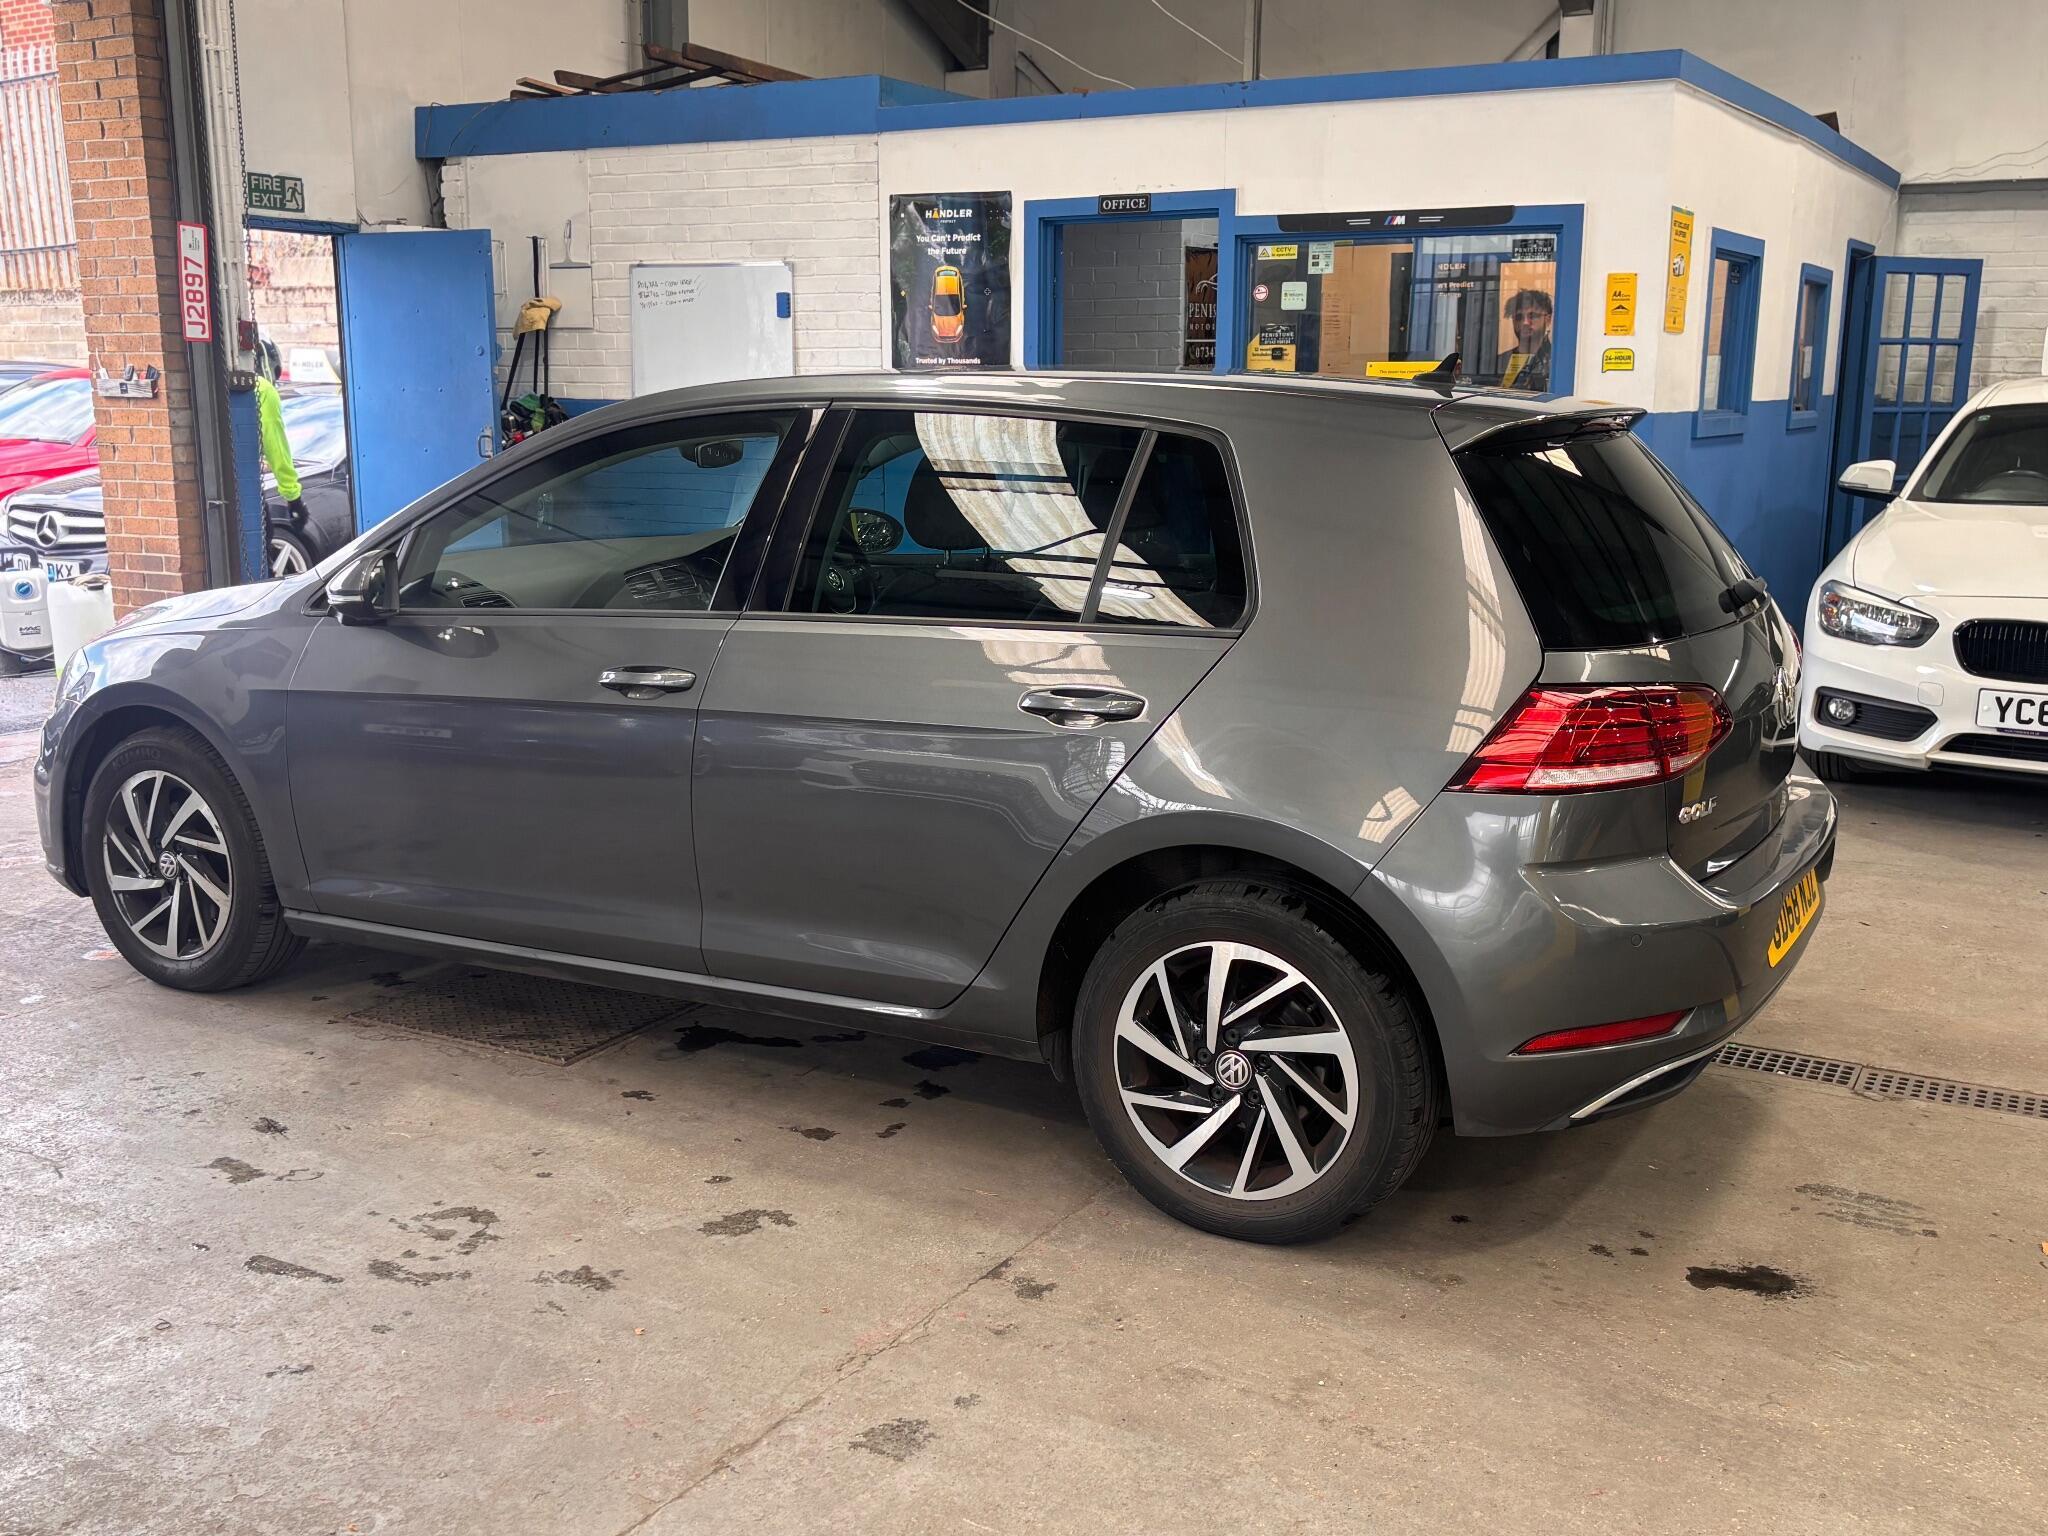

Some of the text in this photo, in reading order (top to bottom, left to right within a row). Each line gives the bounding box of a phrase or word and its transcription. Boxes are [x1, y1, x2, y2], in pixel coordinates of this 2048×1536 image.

[251, 176, 281, 191] FIRE
[252, 193, 282, 208] EXIT
[1103, 199, 1146, 210] OFFICE
[916, 233, 982, 243] You Can't Predict
[927, 246, 967, 256] the Future
[183, 256, 206, 336] J2897
[915, 357, 981, 366] Trusted by Thousands
[1679, 795, 1719, 824] GOLF
